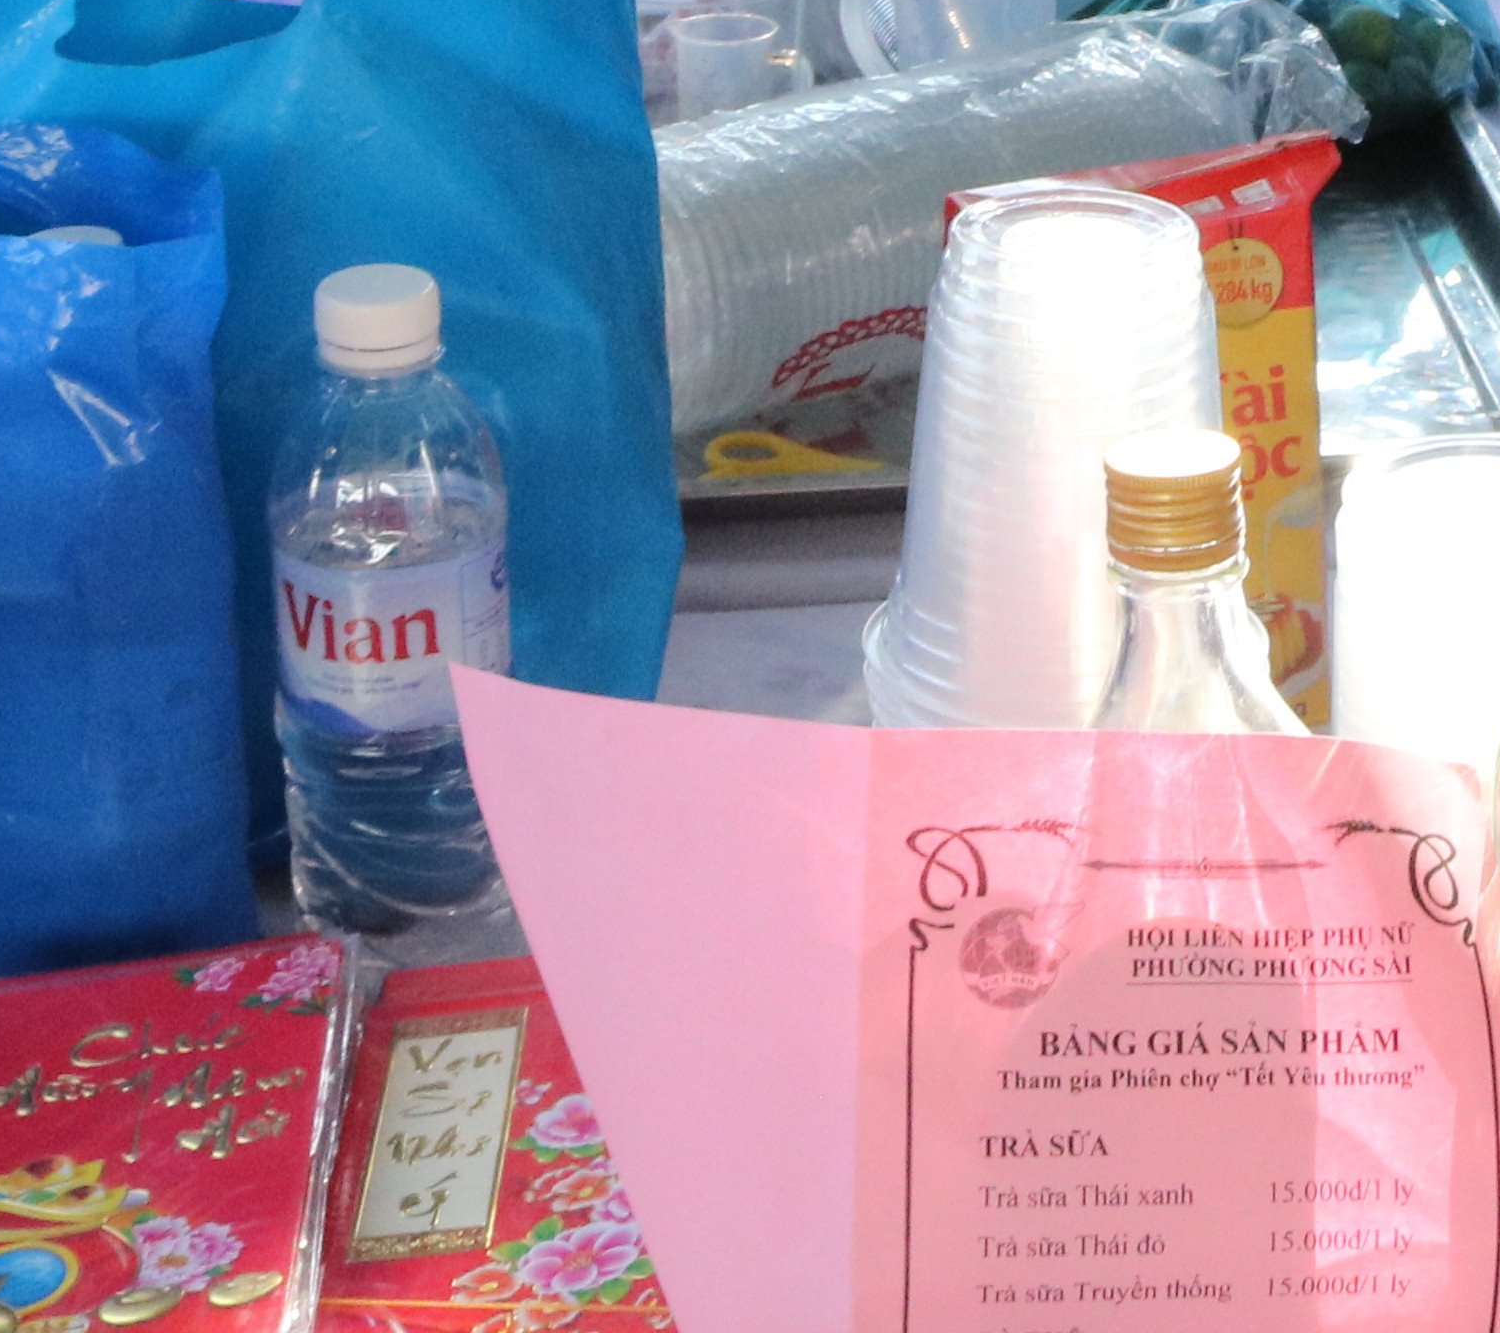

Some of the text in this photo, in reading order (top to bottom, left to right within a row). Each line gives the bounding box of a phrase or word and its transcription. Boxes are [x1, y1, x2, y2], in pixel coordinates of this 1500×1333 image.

[1219, 364, 1287, 424] ài
[1239, 433, 1301, 501] ộc
[282, 578, 442, 666] Vian
[1126, 921, 1417, 953] HỘI LIÊN HIỆP PHỤ NỮ
[1130, 951, 1245, 979] PHƯỜNG
[1253, 954, 1367, 979] PHƯƠNG
[1039, 1023, 1138, 1058] BẢNG
[1147, 1021, 1211, 1058] GIÁ
[1220, 1022, 1290, 1057] SẢN
[997, 1068, 1062, 1091] Tham
[1070, 1068, 1102, 1094] gia
[1110, 1067, 1173, 1090] Phiên
[1180, 1066, 1220, 1093] chợ
[1284, 1065, 1326, 1088] Yêu
[979, 1128, 1110, 1160] TRÀ SỮA
[979, 1184, 1019, 1208] Trà
[1026, 1184, 1068, 1208] sữa
[1076, 1183, 1129, 1208] Thái
[1136, 1183, 1195, 1208] xanh
[1393, 1178, 1415, 1207] ly
[978, 1235, 1018, 1259] Trà
[1026, 1235, 1067, 1257] sữa
[1075, 1234, 1128, 1257] Thái
[1392, 1227, 1414, 1255] ly
[976, 1282, 1017, 1305] Trà
[1024, 1281, 1065, 1303] sữa
[1072, 1275, 1158, 1307] Truyền
[1166, 1273, 1233, 1304] thống
[1390, 1273, 1411, 1299] ly
